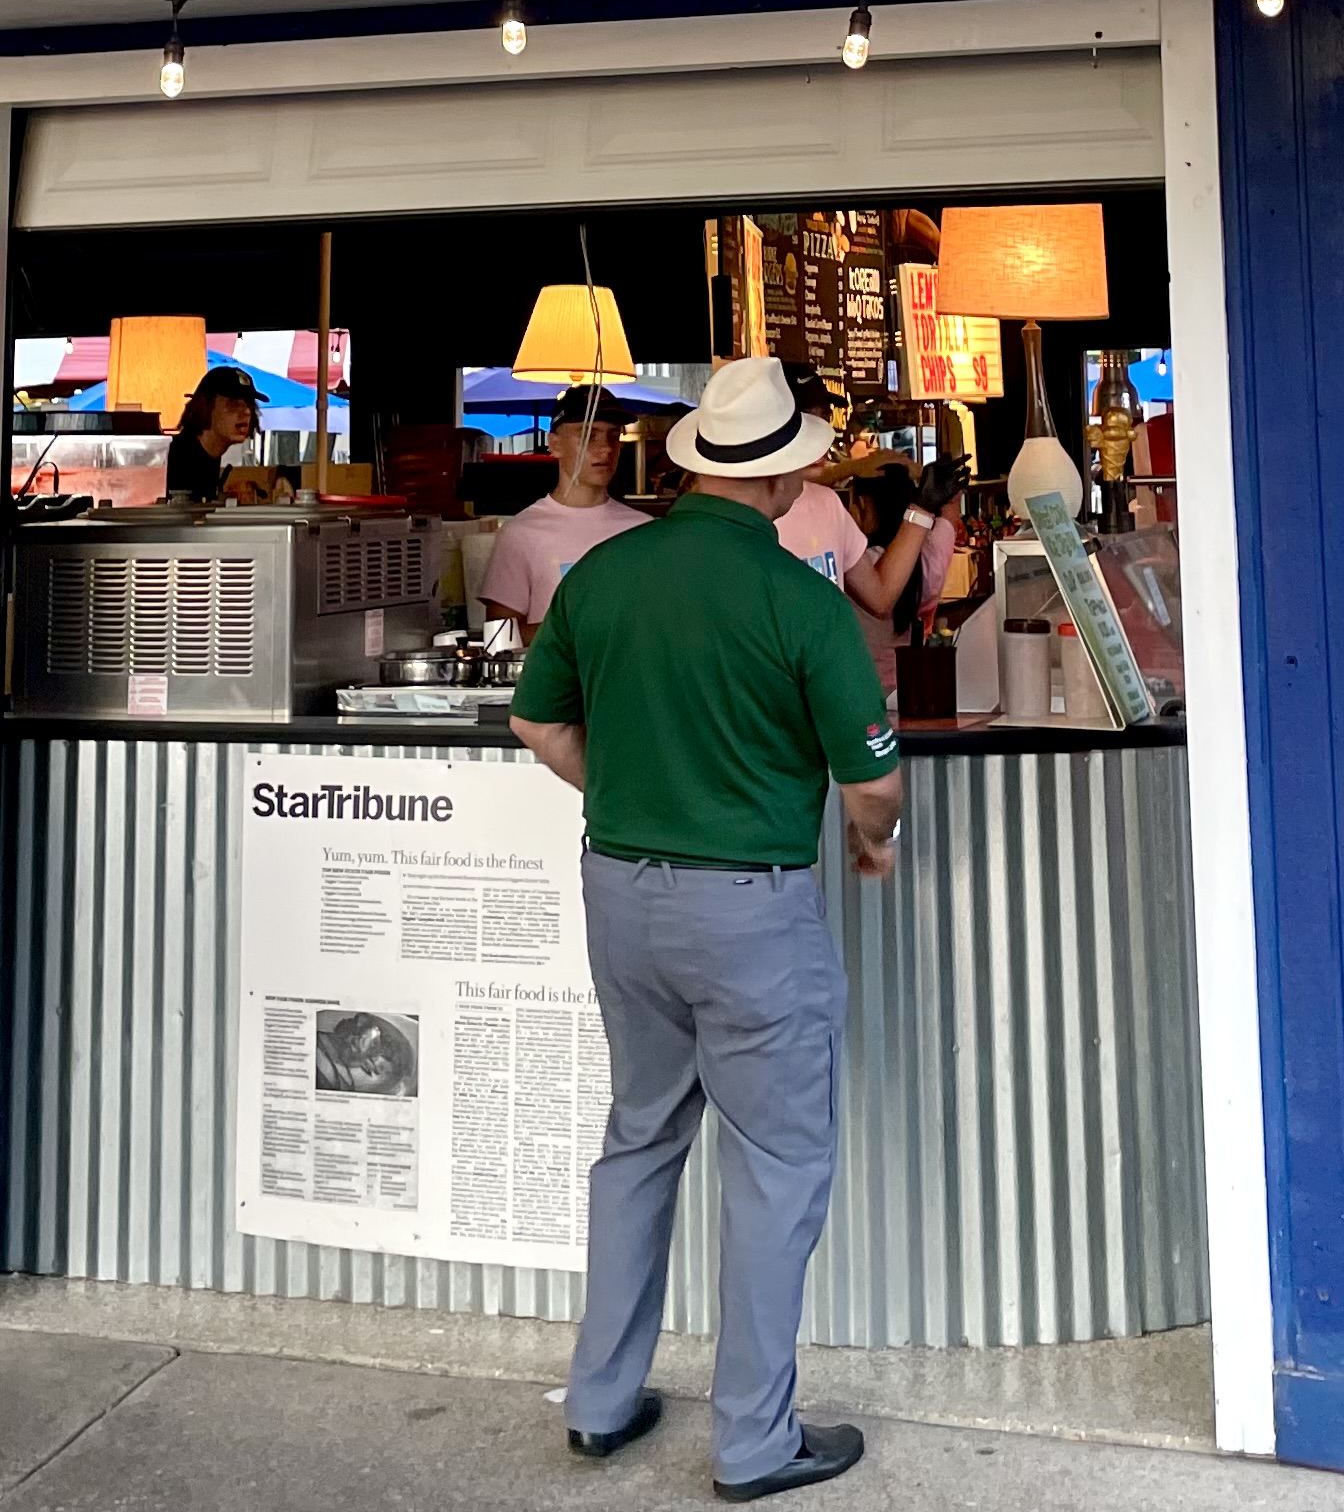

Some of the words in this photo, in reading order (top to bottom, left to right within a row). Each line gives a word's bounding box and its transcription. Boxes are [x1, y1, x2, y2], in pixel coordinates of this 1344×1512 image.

[803, 231, 835, 261] PIZZA
[920, 354, 957, 393] CHIPS
[252, 783, 453, 822] StarTribune
[322, 847, 355, 865] Yum,
[357, 852, 388, 868] yum.
[391, 849, 419, 865] This
[420, 850, 443, 866] fair
[443, 851, 471, 867] food
[474, 854, 484, 868] is
[486, 853, 507, 869] the
[508, 854, 544, 870] finest
[455, 980, 485, 999] This
[488, 982, 512, 1000] fair
[514, 984, 545, 1002] food
[548, 987, 559, 1002] is
[562, 986, 585, 1004] the
